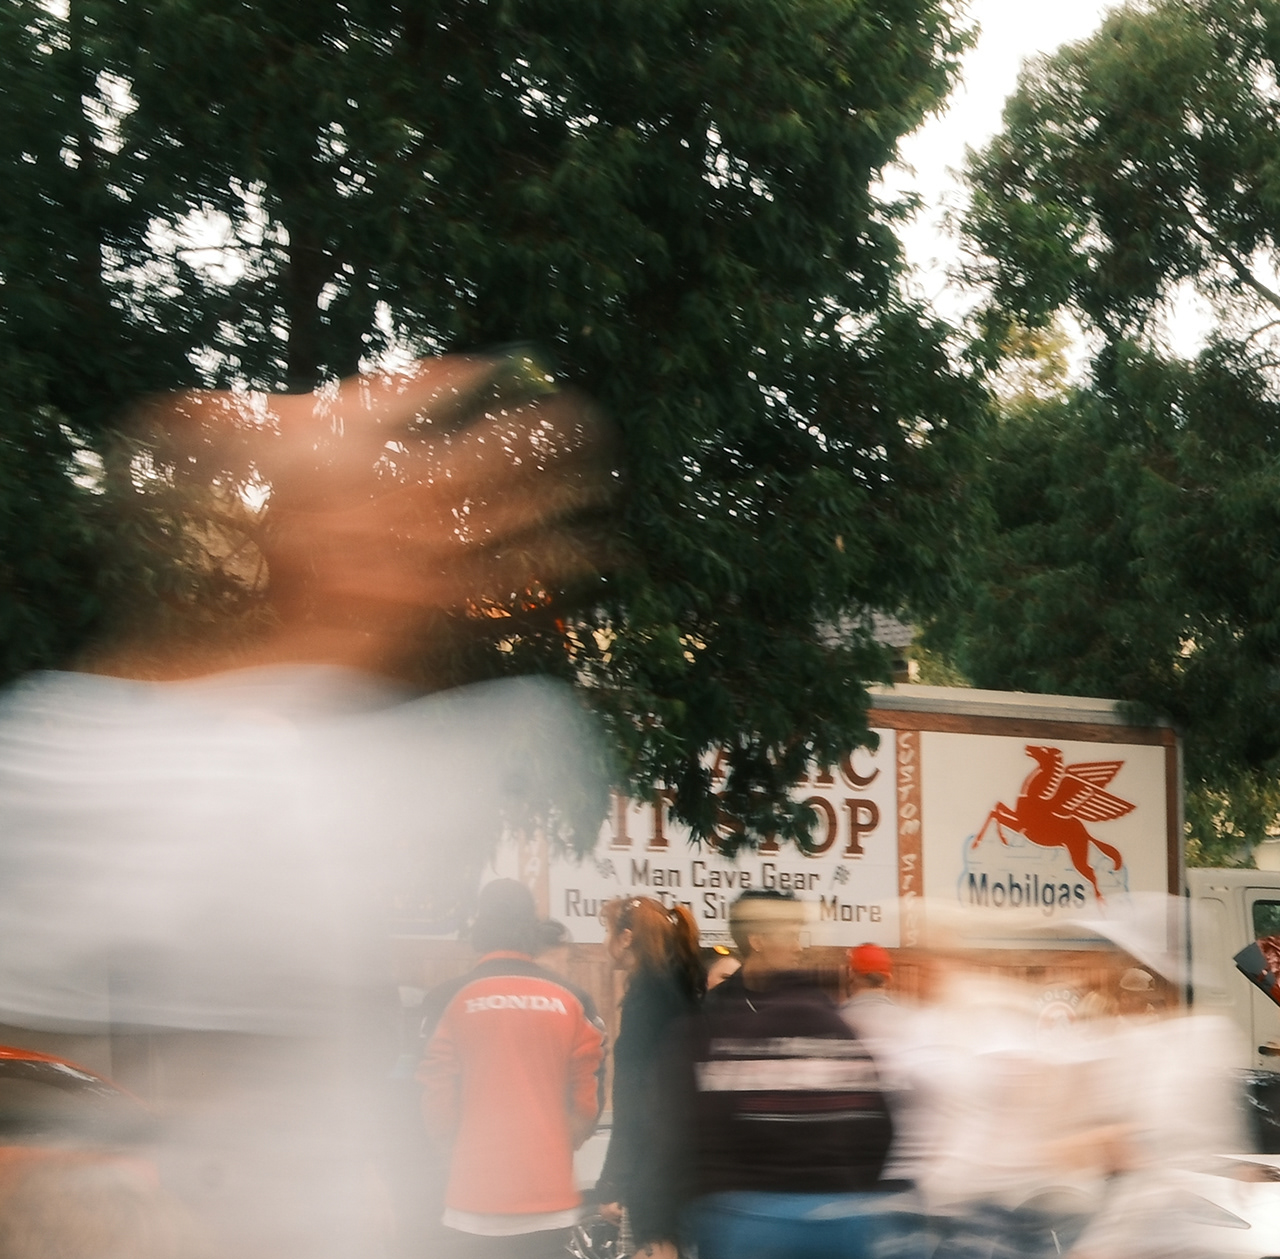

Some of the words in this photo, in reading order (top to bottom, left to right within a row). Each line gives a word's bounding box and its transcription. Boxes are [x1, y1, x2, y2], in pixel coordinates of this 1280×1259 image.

[632, 858, 681, 887] Man
[692, 861, 750, 889] Cave
[763, 863, 819, 891] Gear
[820, 895, 882, 923] More
[968, 872, 1086, 917] Mobilgas
[464, 995, 568, 1015] HONDA
